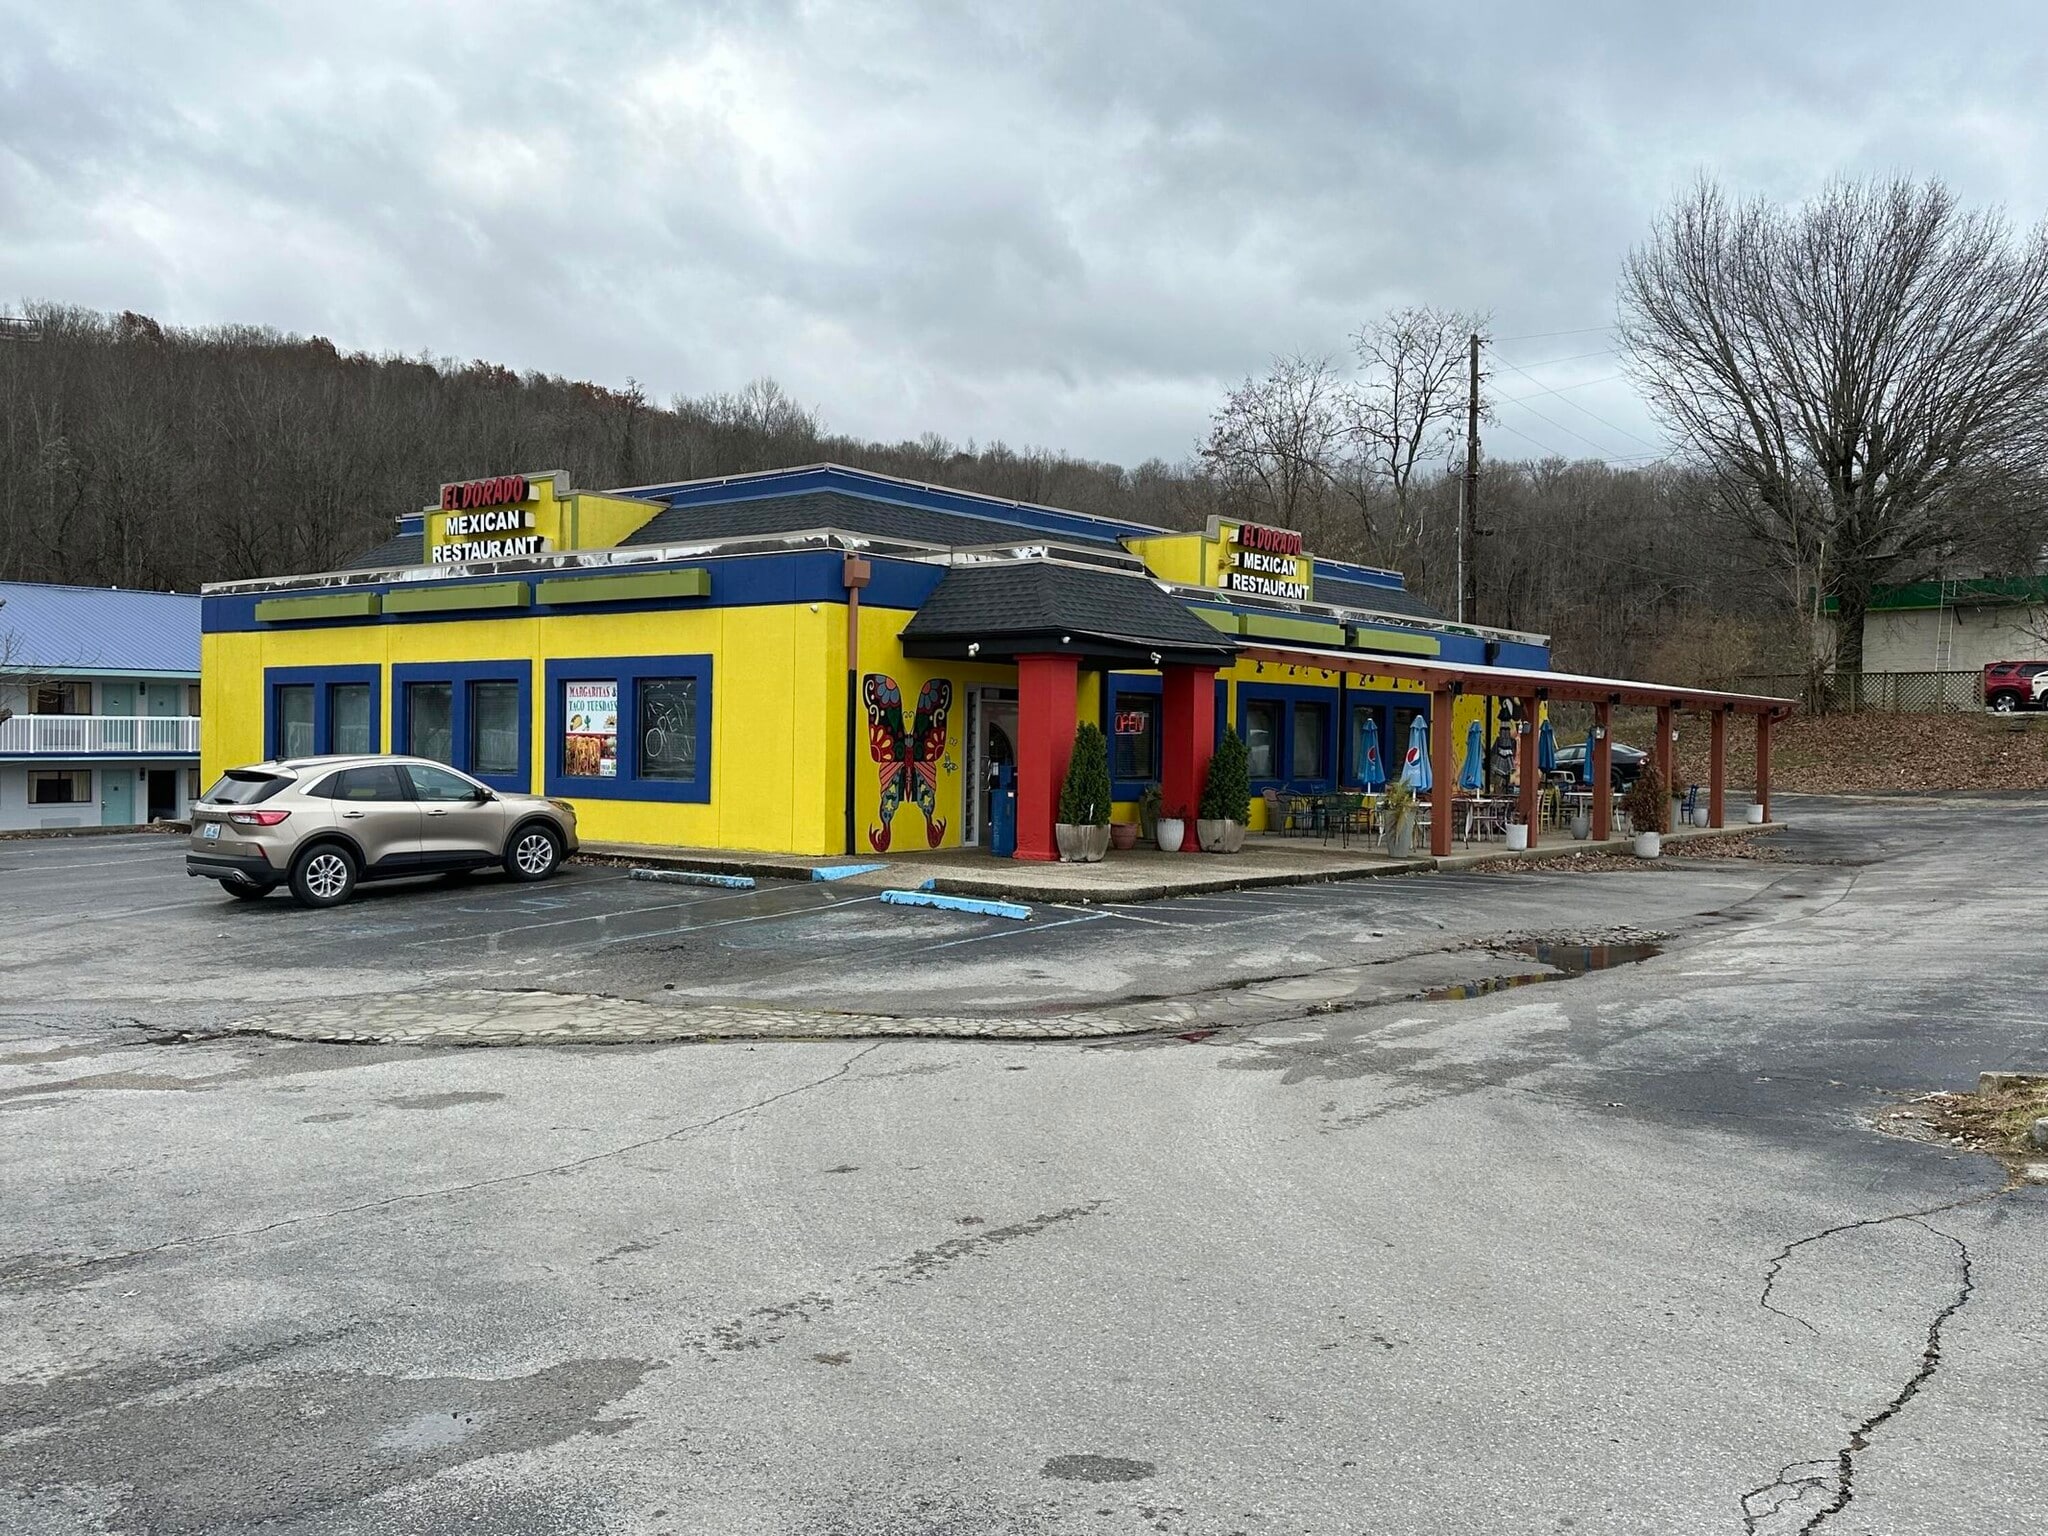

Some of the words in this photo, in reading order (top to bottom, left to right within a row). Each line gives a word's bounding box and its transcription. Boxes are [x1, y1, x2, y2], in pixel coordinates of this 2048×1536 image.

[443, 485, 459, 509] EL
[462, 475, 524, 507] DORADO
[446, 510, 519, 535] MEXICAN
[432, 536, 538, 563] RESTAURANT
[1243, 524, 1256, 547] EL
[1258, 527, 1302, 555] DORADO
[1244, 552, 1297, 576] MEXICAN
[1233, 573, 1309, 600] RESTAURANT
[569, 686, 610, 697] MARGARITAS
[569, 700, 584, 711] TACO
[587, 700, 617, 711] TUESDAYS
[646, 700, 688, 757] OPEN
[1115, 713, 1145, 732] OPEN
